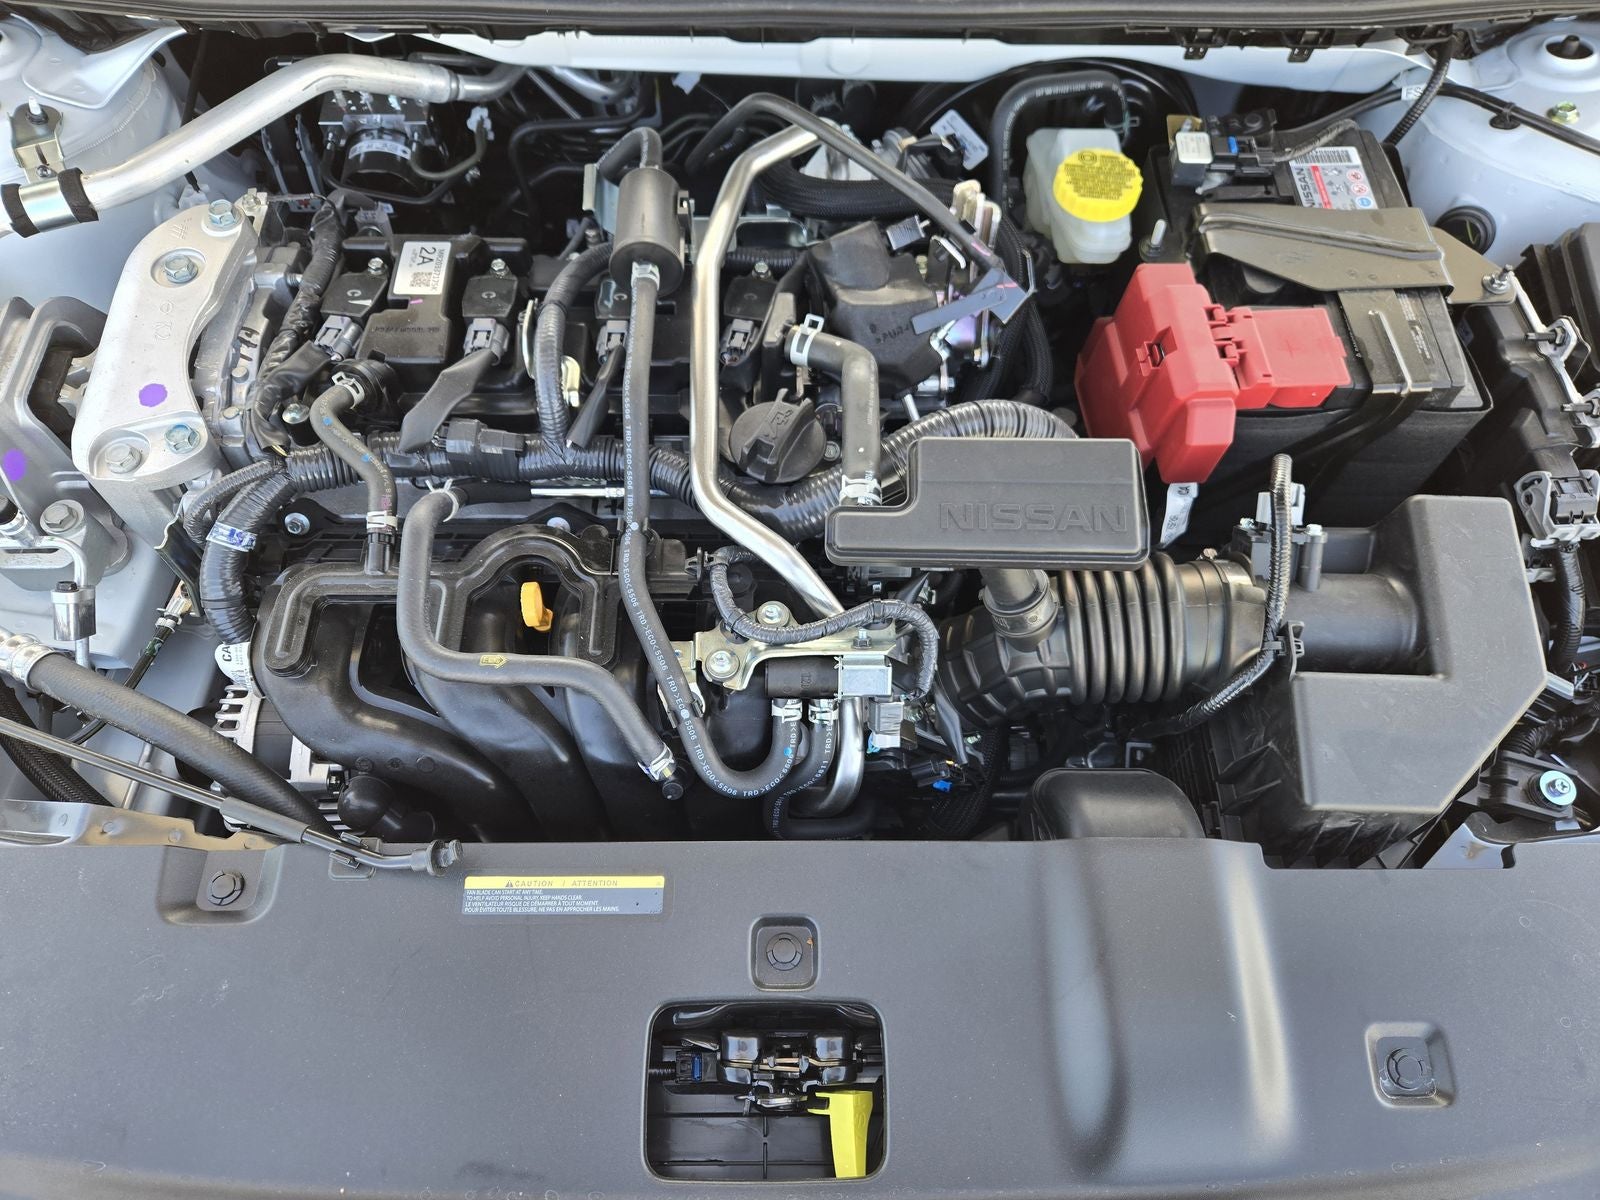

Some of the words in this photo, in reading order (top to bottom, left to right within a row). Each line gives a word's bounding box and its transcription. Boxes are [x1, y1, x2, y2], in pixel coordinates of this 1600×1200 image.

[417, 247, 437, 265] 2A
[938, 502, 1128, 533] NISSAN
[221, 645, 233, 662] CA
[514, 880, 554, 888] CAUTION
[571, 879, 618, 887] ATTENTION
